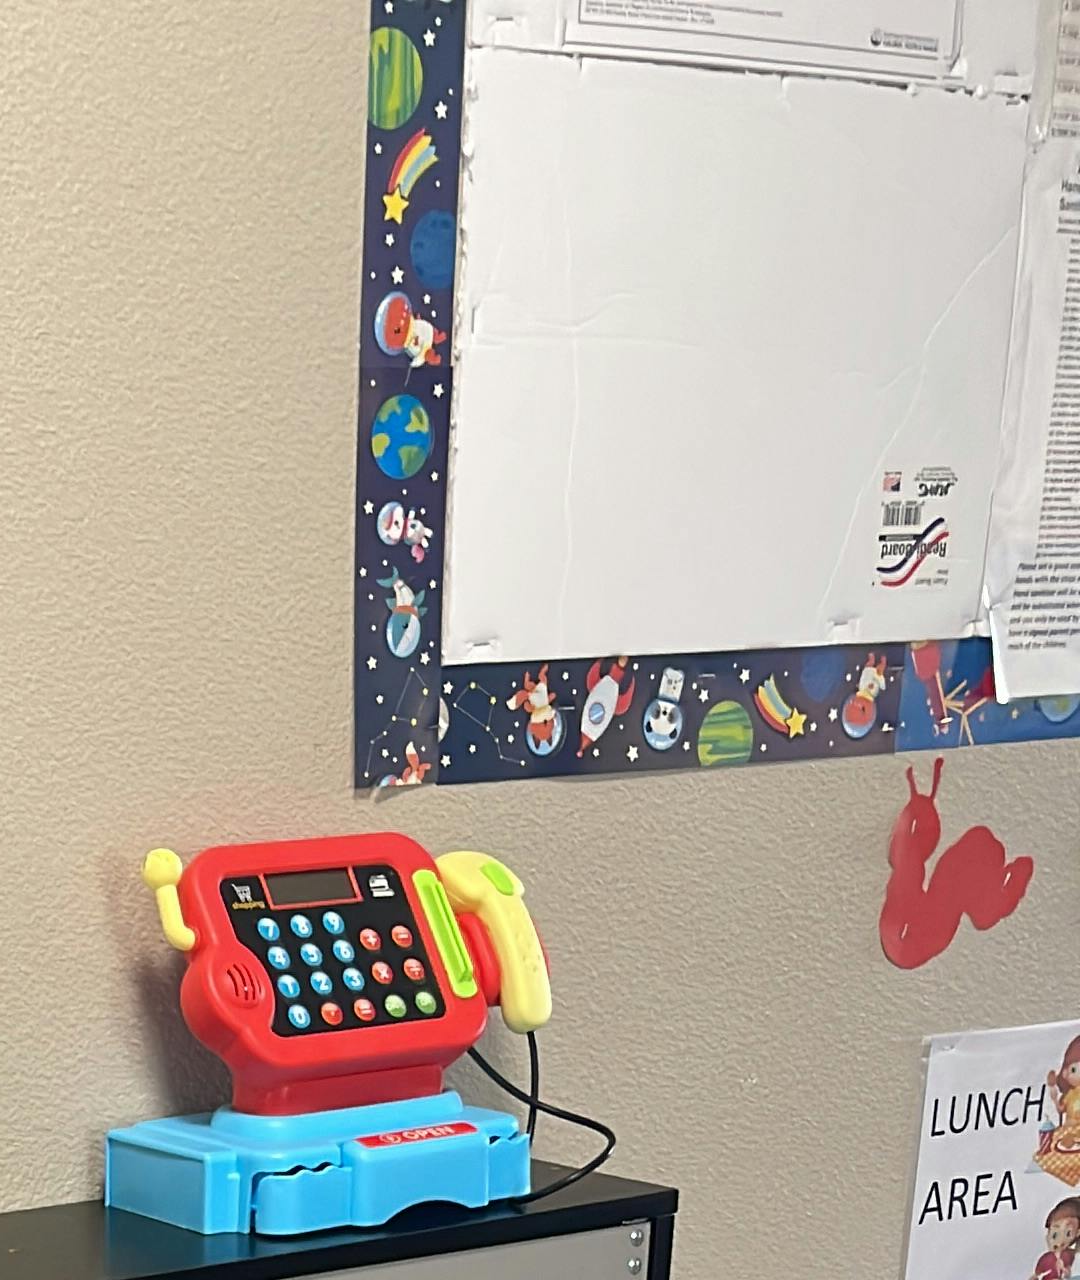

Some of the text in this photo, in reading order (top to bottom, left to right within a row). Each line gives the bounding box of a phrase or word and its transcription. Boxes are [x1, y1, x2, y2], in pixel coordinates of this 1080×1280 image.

[402, 1126, 455, 1140] OPEN
[930, 1083, 1047, 1138] LUNCH
[918, 1170, 1018, 1226] AREA
